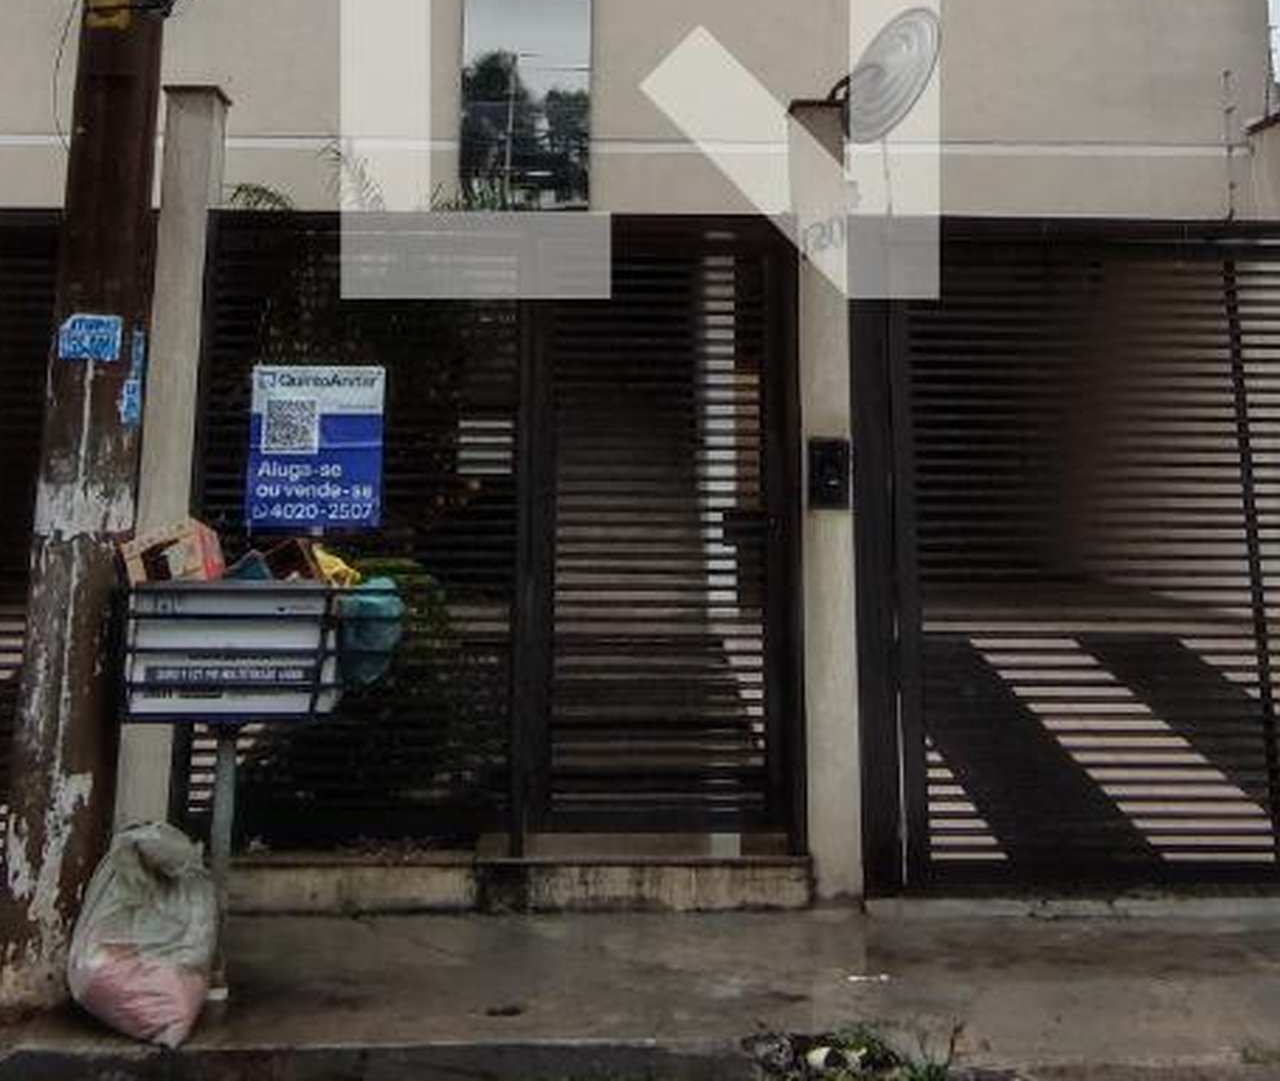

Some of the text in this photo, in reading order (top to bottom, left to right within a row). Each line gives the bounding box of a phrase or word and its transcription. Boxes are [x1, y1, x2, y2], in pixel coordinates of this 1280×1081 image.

[258, 461, 341, 481] Aluga-se
[256, 481, 373, 499] ou venda-se
[269, 502, 373, 520] 4020-2507
